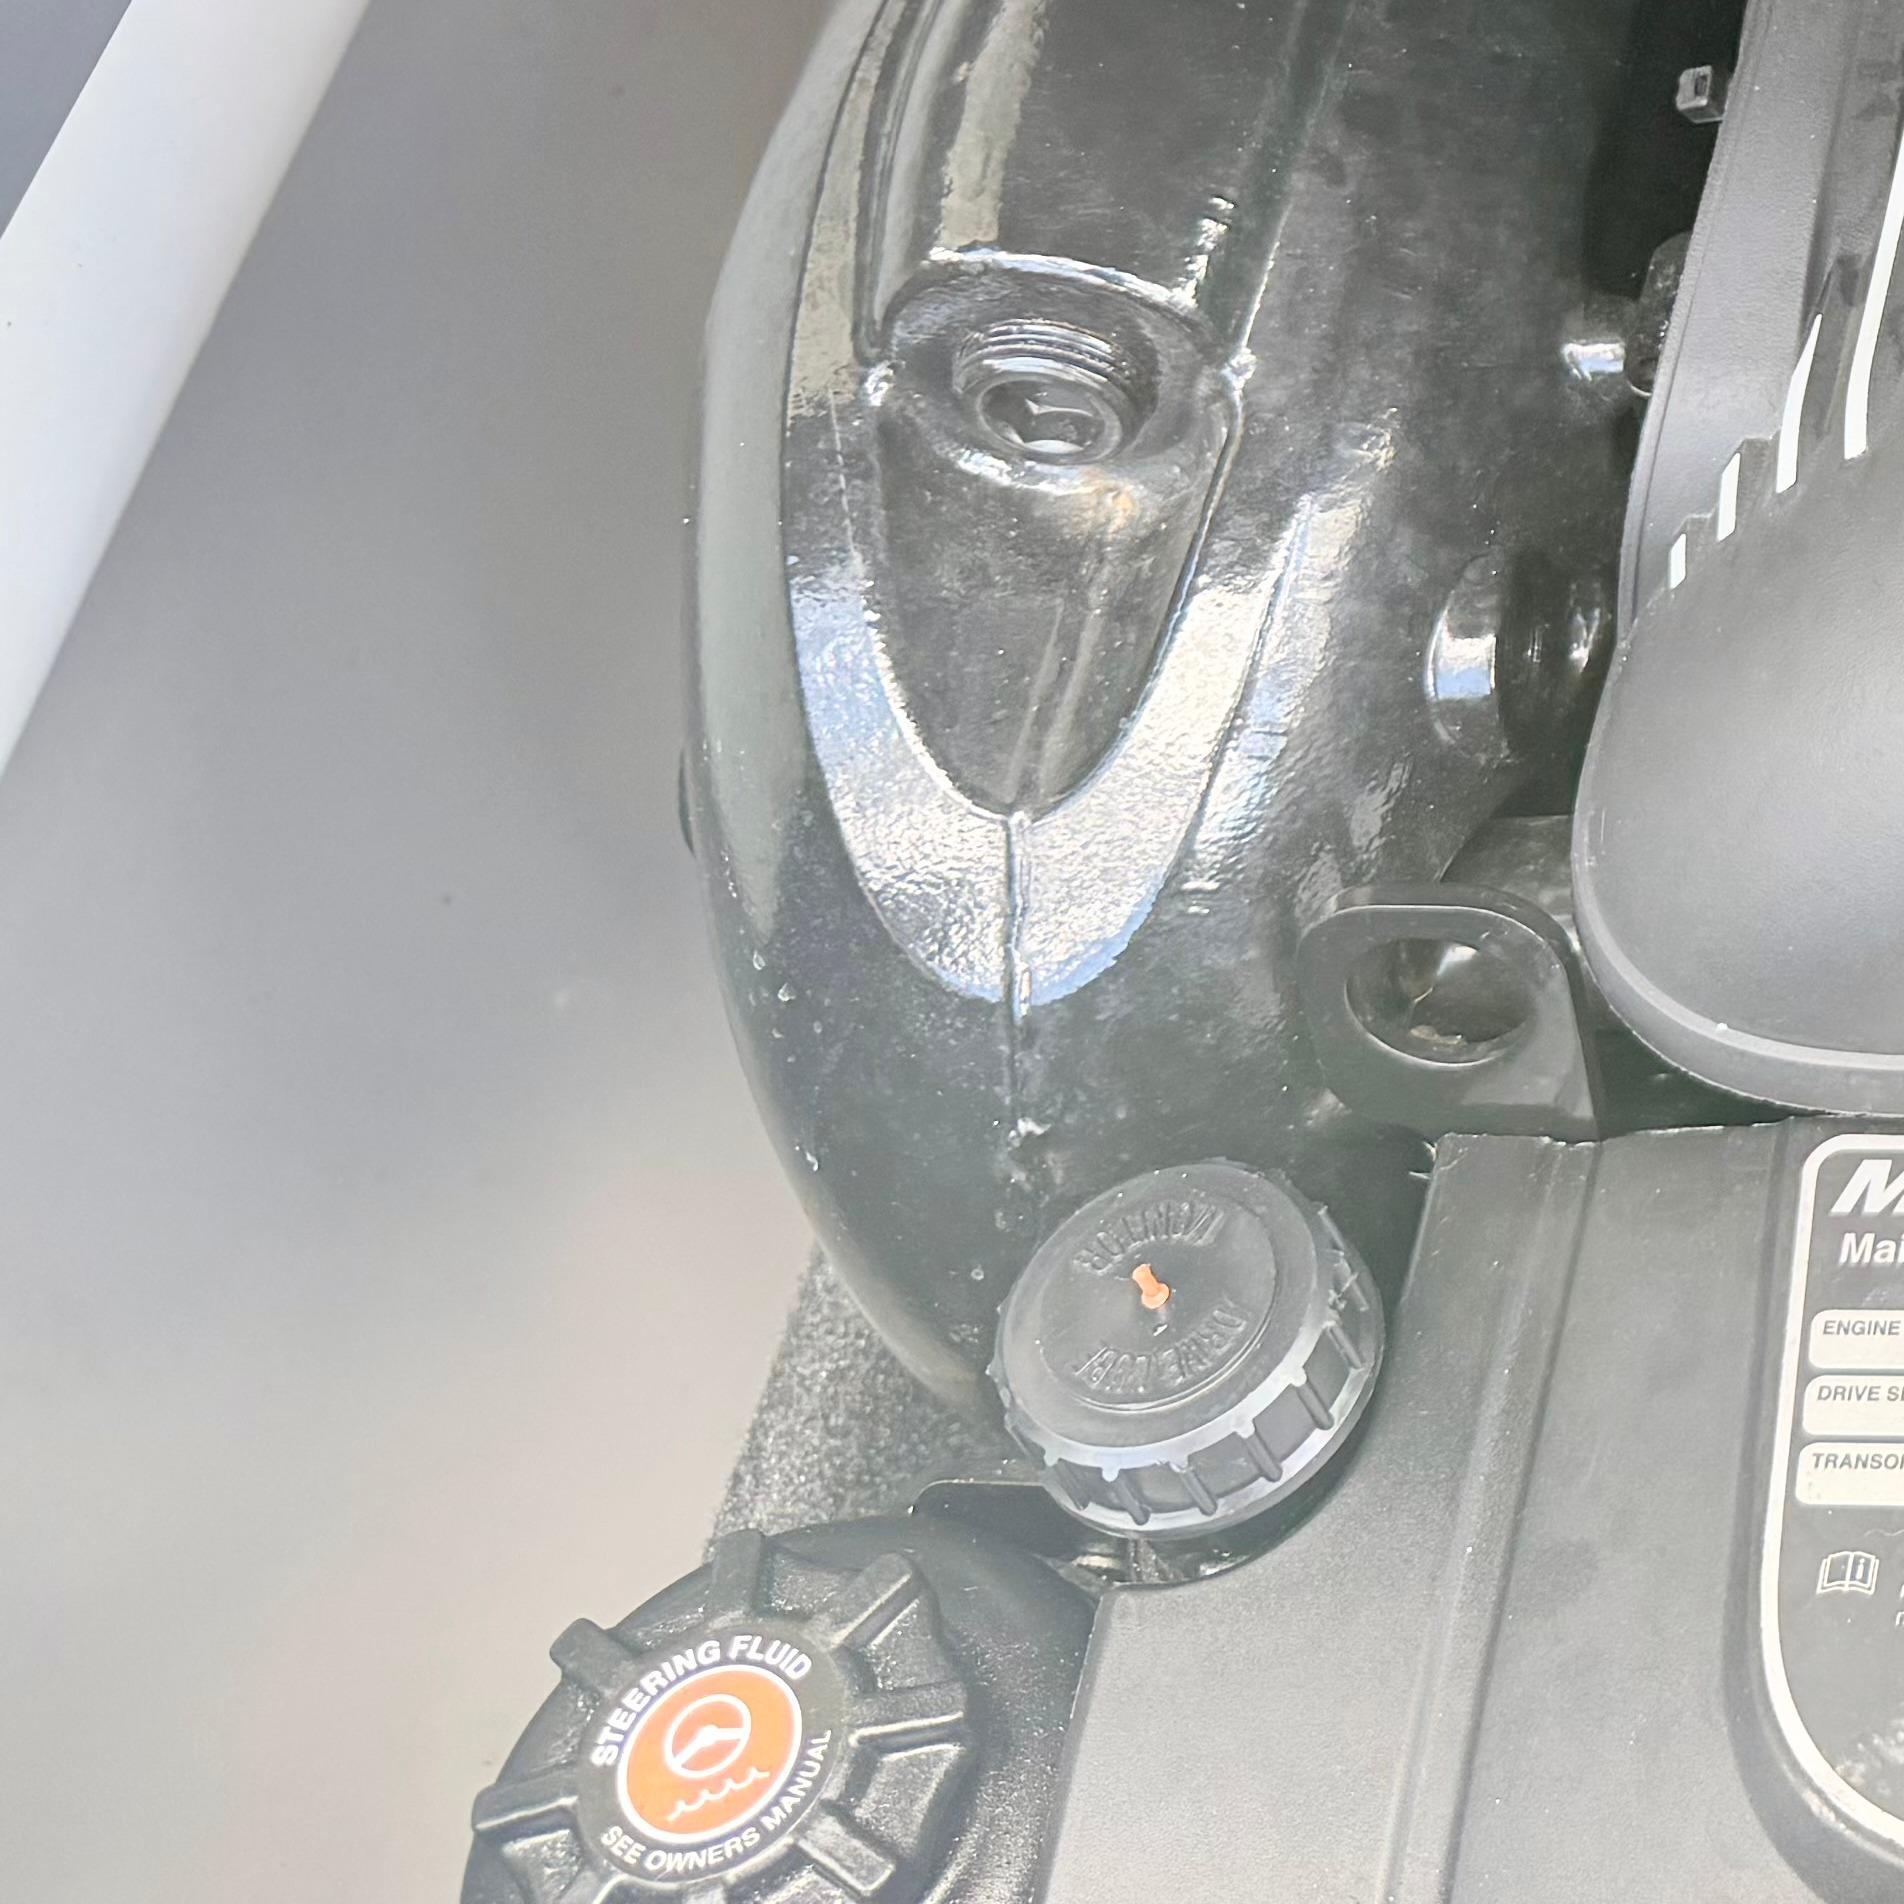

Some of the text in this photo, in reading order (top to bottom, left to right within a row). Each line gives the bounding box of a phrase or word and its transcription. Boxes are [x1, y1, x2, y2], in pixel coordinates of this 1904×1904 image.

[1823, 1320, 1900, 1335] ENGINE
[1818, 1386, 1880, 1401] DRIVE
[590, 1634, 813, 1766] STEERING FLUID
[601, 1729, 832, 1872] SEE OWNERS MANUAL
